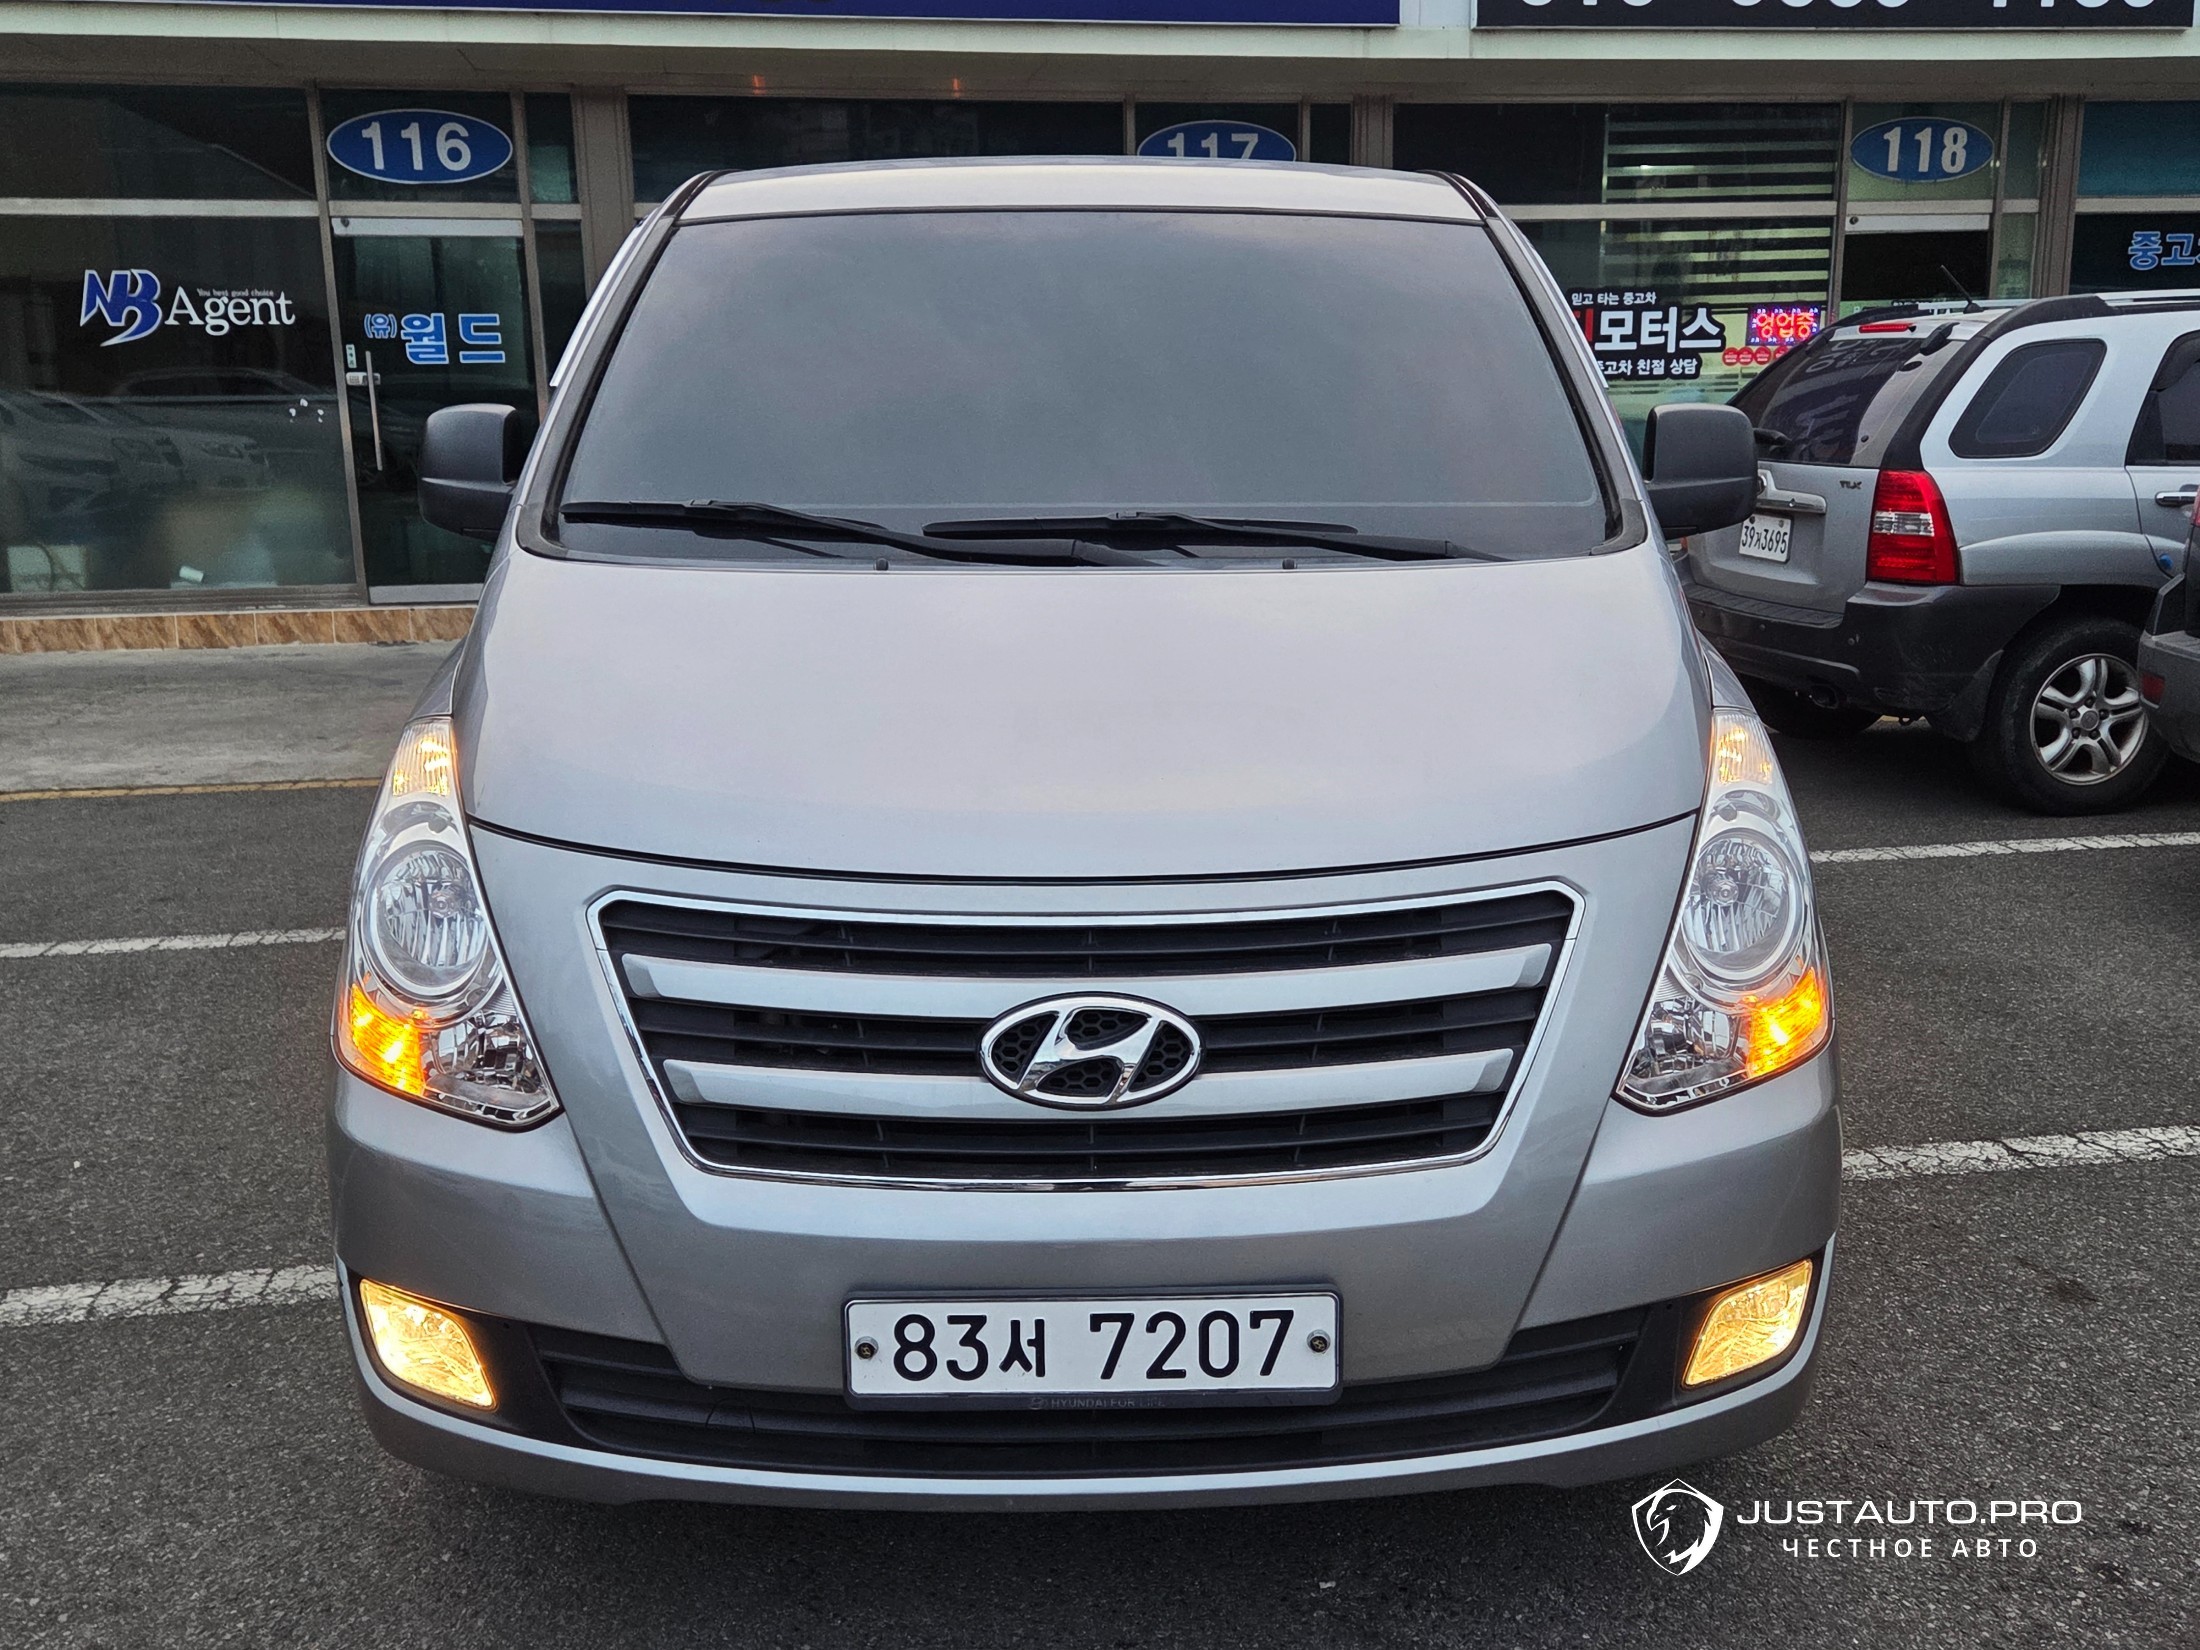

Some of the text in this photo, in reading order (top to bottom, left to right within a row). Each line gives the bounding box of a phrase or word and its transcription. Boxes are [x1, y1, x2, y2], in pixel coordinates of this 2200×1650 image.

[361, 121, 471, 171] 116
[1168, 132, 1259, 159] 117
[1883, 126, 1968, 173] 118
[2128, 231, 2200, 271] 중고
[164, 286, 296, 336] Agent
[1571, 291, 1657, 306] 믿고 타는 중고차
[1756, 312, 1814, 340] 영업중
[1637, 358, 1665, 375] 친절
[1670, 358, 1698, 375] 상담
[893, 1309, 1295, 1381] 83서 7207
[1051, 1398, 1107, 1408] HYUNDAI
